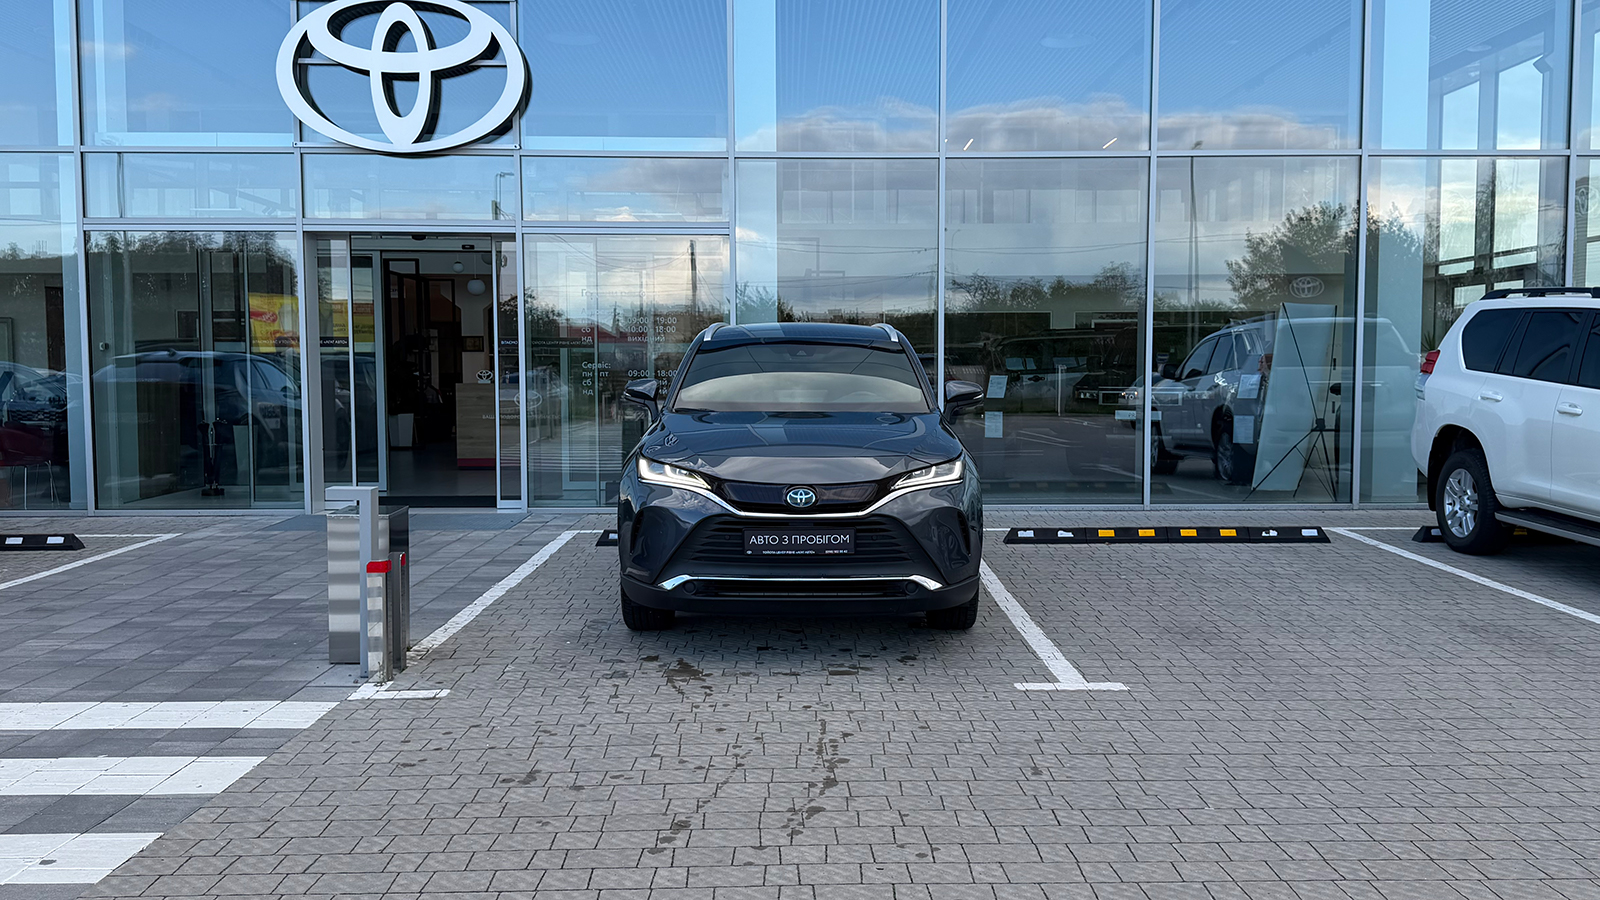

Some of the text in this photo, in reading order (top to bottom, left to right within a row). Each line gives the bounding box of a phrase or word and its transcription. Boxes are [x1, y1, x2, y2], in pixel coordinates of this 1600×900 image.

[656, 316, 677, 324] 19:00
[655, 325, 676, 333] 18:00
[627, 334, 665, 343] вихідний
[581, 361, 611, 370] Сервіс:
[628, 369, 650, 377] 09:00
[657, 369, 678, 377] 18:00
[582, 378, 592, 386] сб
[749, 534, 850, 545] АВТО З ПРОБІГОМ
